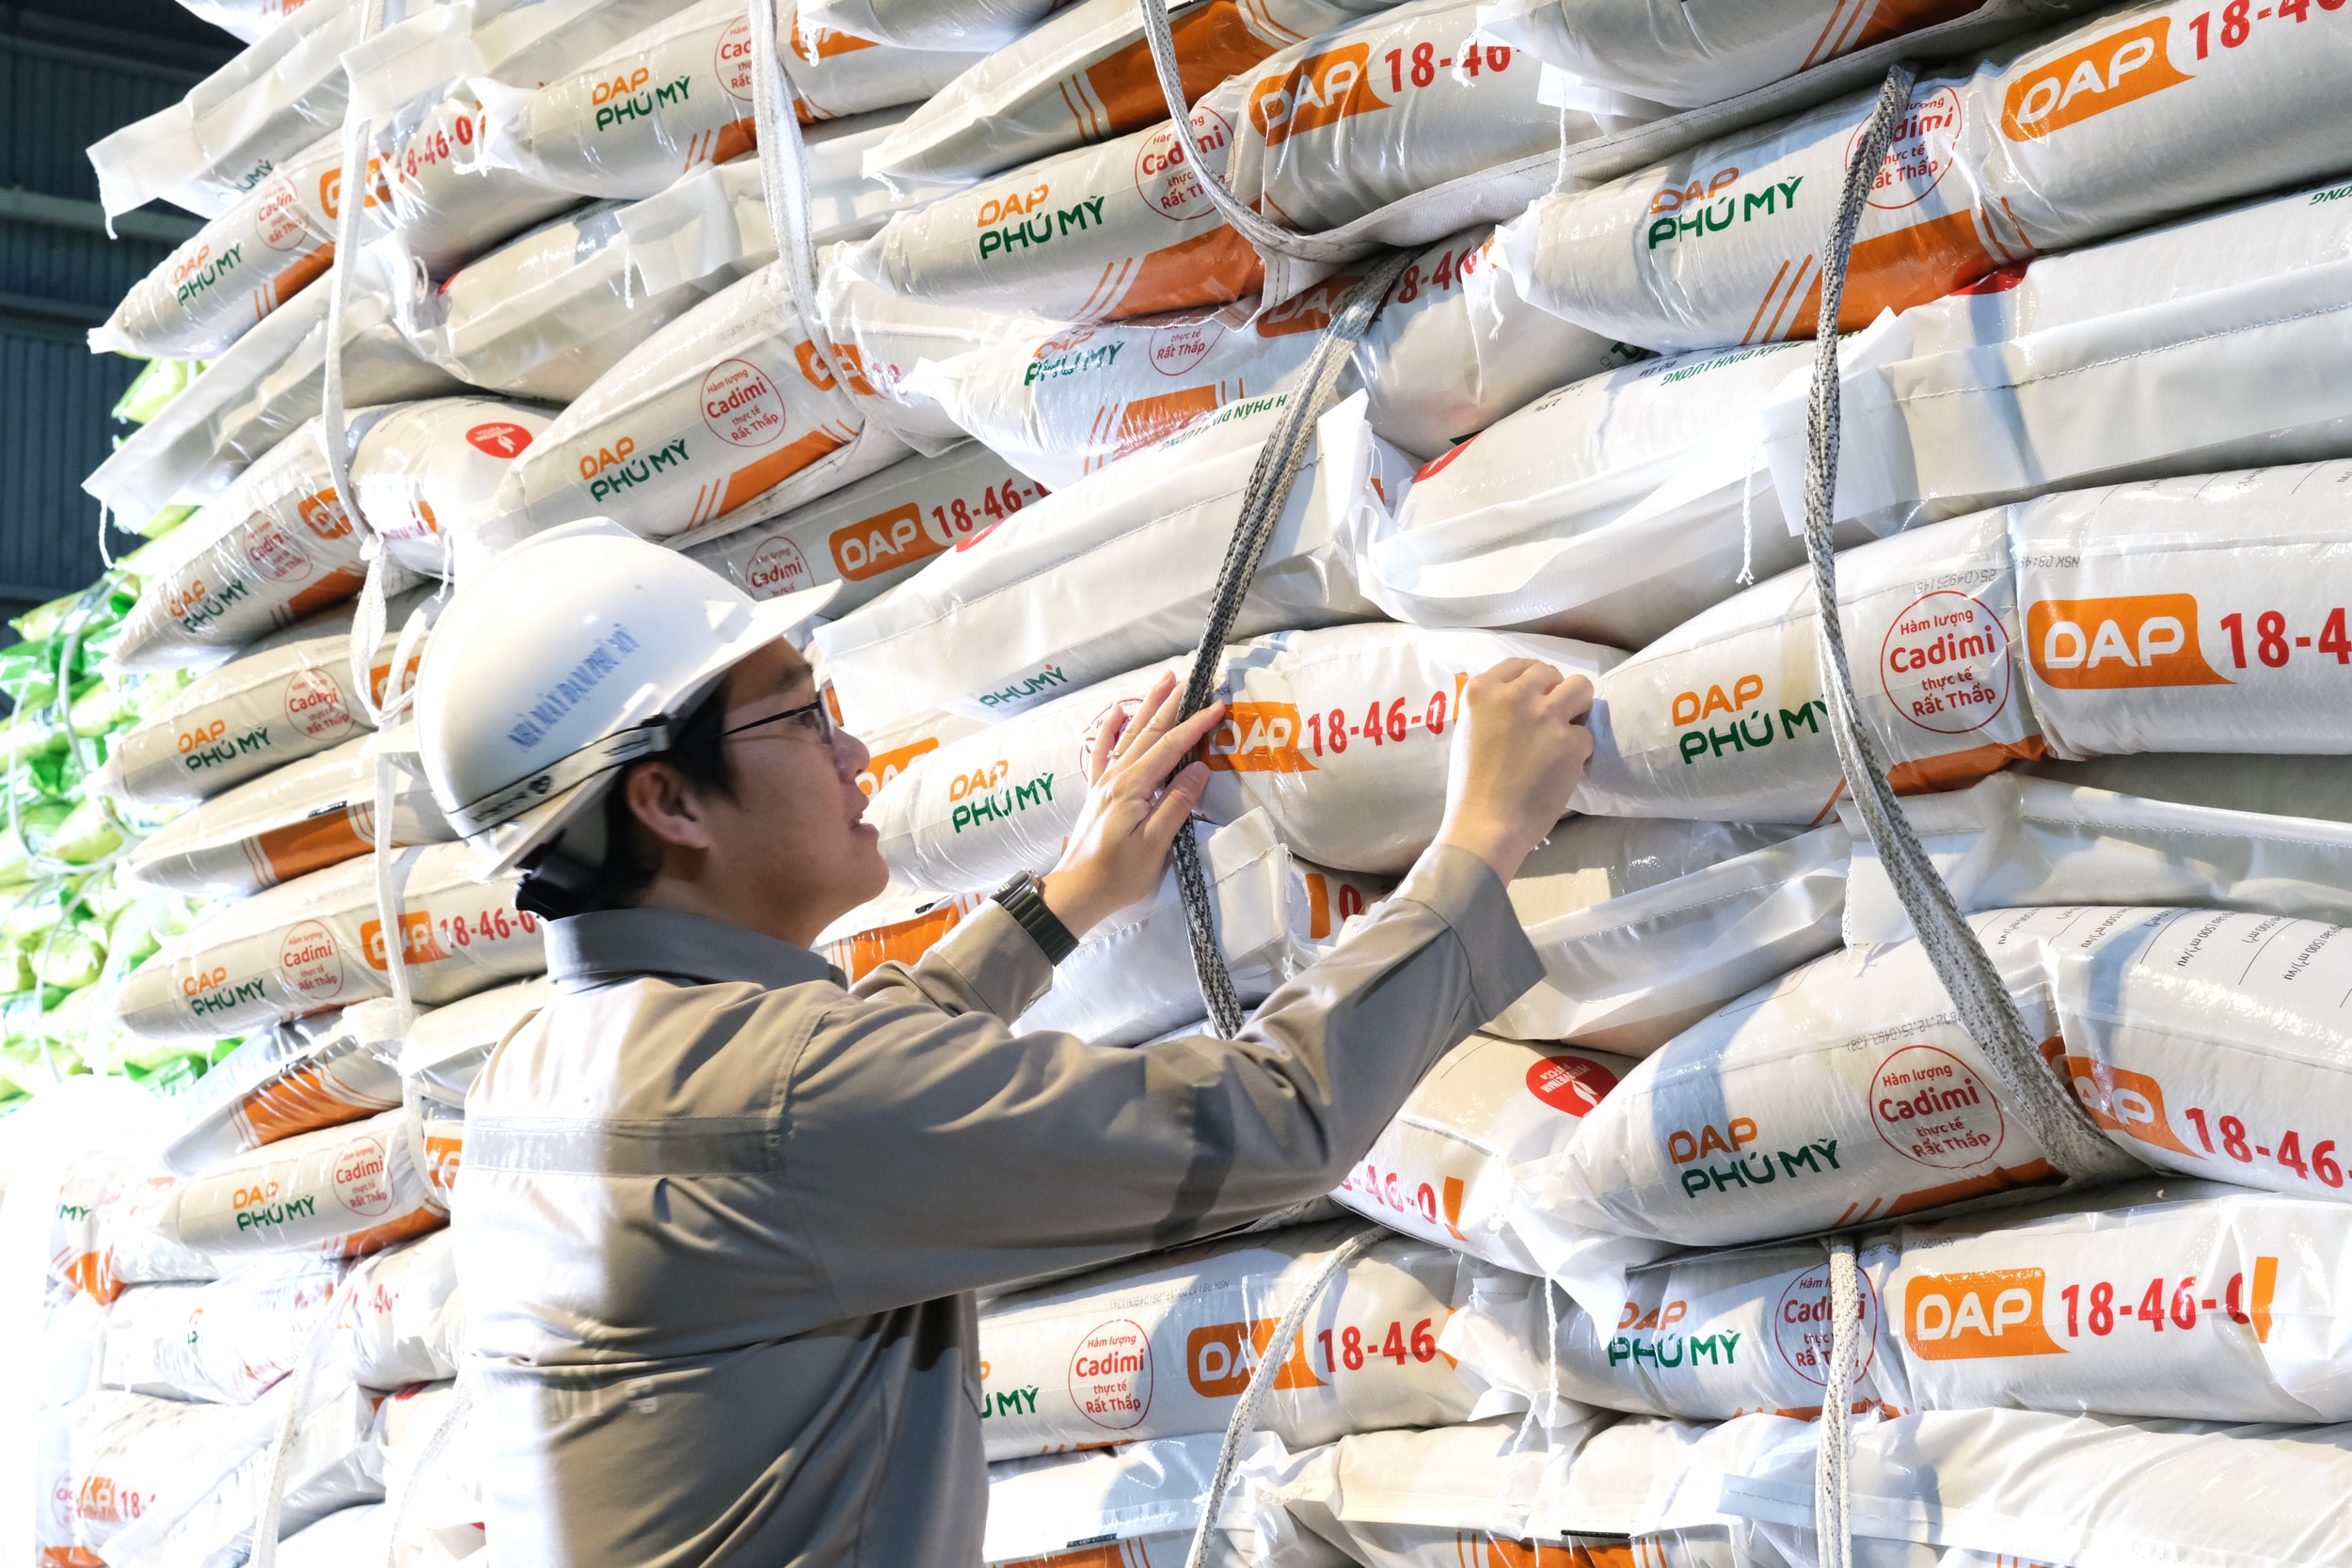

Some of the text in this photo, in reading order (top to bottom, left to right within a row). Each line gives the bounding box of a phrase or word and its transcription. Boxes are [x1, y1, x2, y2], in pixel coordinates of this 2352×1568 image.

[592, 67, 649, 106] DAP
[2016, 36, 2155, 124] DAP
[1896, 157, 1940, 185] Thấp
[977, 183, 1049, 229] DAP
[1649, 167, 1740, 214] DAP
[1157, 341, 1205, 360] Rất Thấp
[706, 376, 768, 420] Cadimi
[707, 378, 728, 394] Hàm
[731, 412, 780, 443] Rất Thấp
[580, 436, 635, 480] DAP
[840, 478, 1051, 571] DAP 18-46-
[1900, 609, 1974, 636] Hàm lượng
[1889, 624, 1996, 674] Cadimi
[2044, 616, 2185, 669] DAP
[1921, 665, 1974, 693] thực tế
[1672, 673, 1763, 727] DAP
[1912, 683, 1997, 719] Rất Thấp
[178, 720, 226, 753] DAP
[1308, 690, 1447, 757] 18-46-0
[949, 759, 1009, 802] DAP
[283, 940, 333, 968] Cadimi
[1883, 1062, 1953, 1087] Hàm lượng
[1878, 1078, 1980, 1123] Cadimi
[1667, 1117, 1758, 1164] DAP
[1915, 1116, 1964, 1137] thực tế
[1912, 1130, 1992, 1159] Rất Thấp
[336, 1155, 385, 1185] Cadimi
[1784, 1292, 1867, 1323] Cadii
[1915, 1288, 2032, 1340] DAP
[1087, 1332, 1136, 1348] Hàm lượng
[1075, 1347, 1145, 1378] Cadimi
[1085, 1392, 1141, 1414] Rất Thấp
[1093, 1378, 1128, 1395] thực tế
